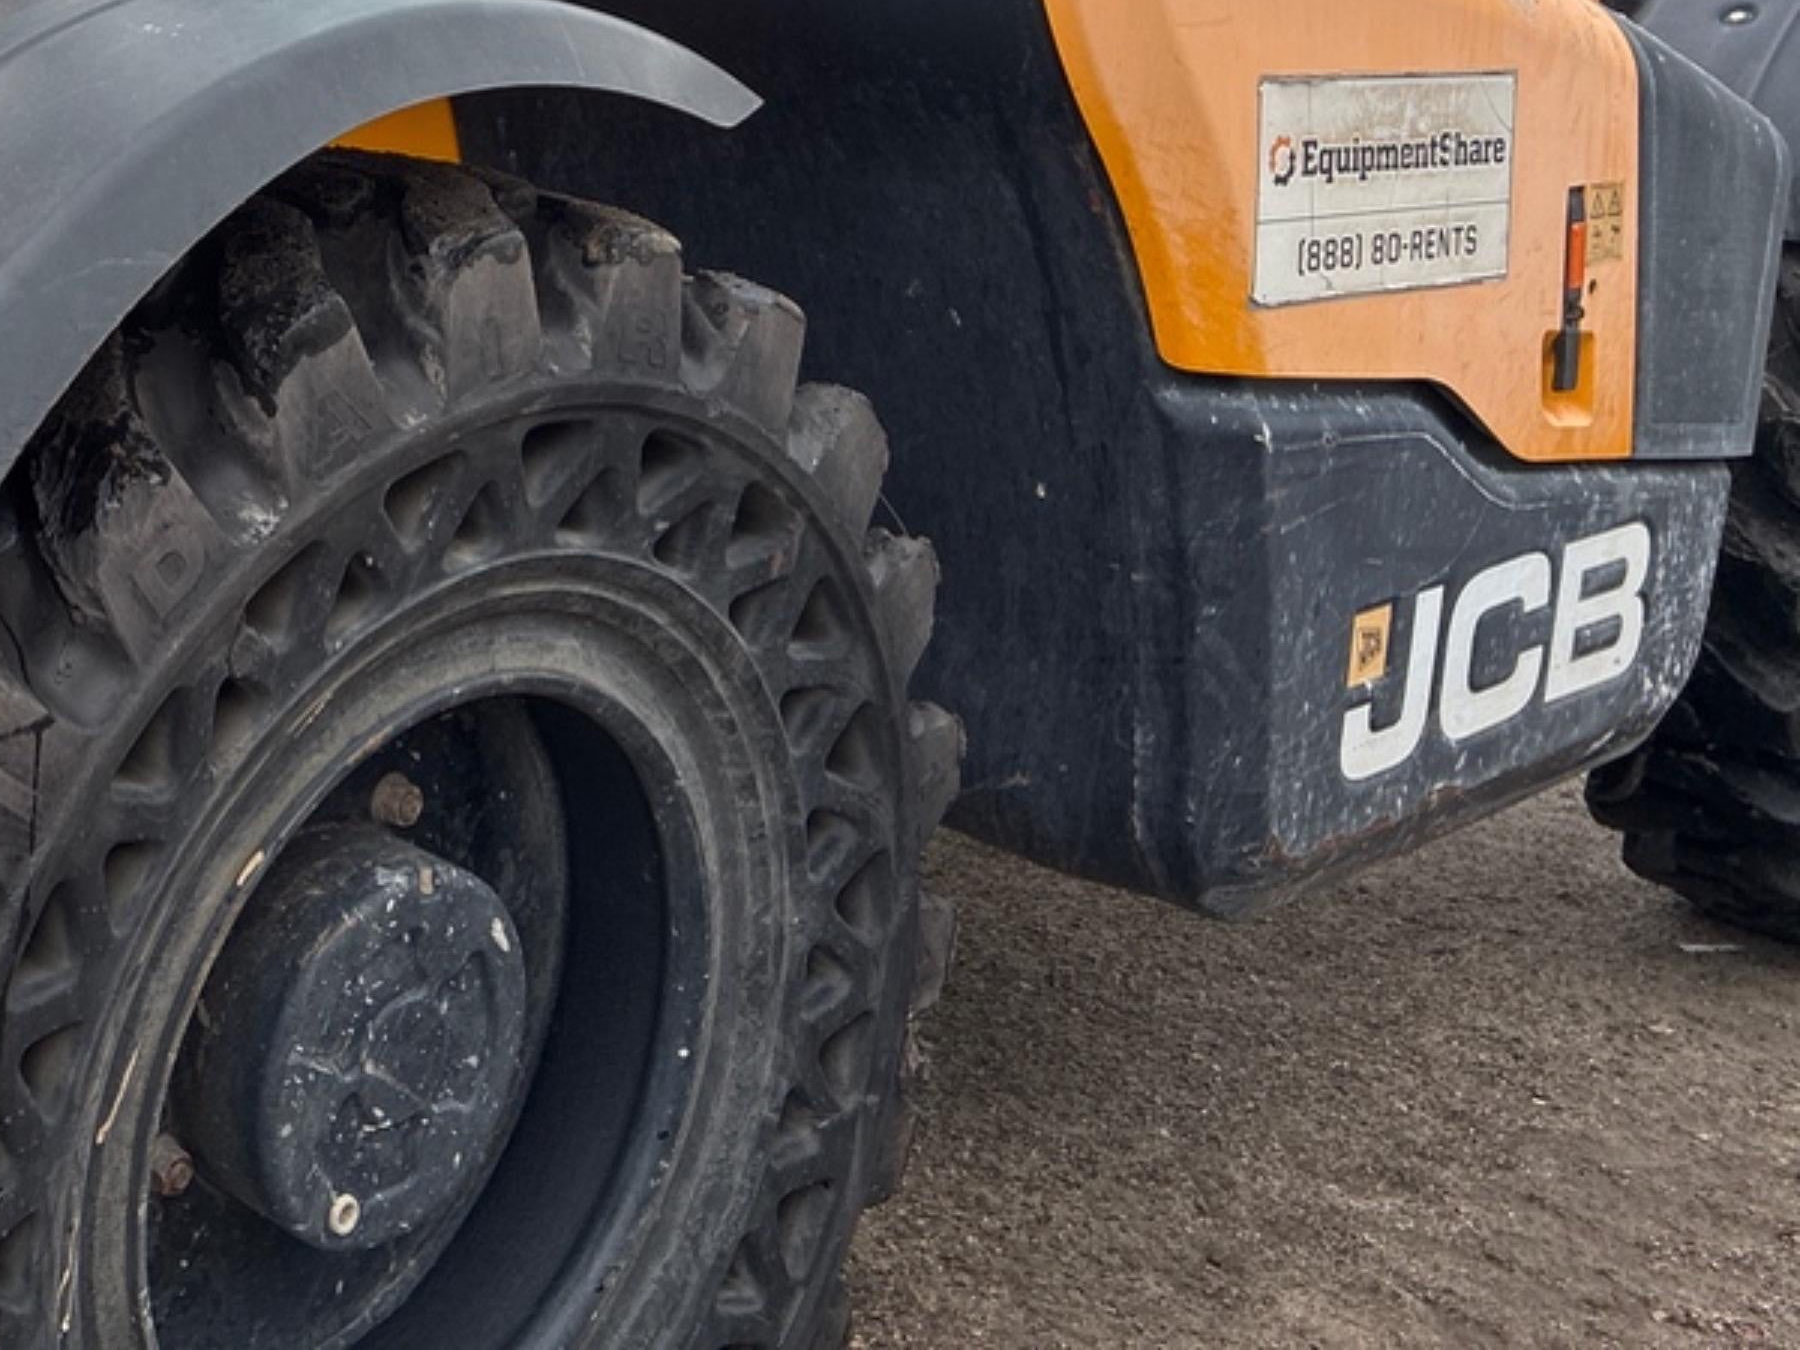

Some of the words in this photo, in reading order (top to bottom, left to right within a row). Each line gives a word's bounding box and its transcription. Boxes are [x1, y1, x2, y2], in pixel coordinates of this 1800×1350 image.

[1302, 132, 1506, 183] EquipmentShare
[1298, 233, 1363, 277] (888)
[1370, 224, 1478, 264] 80-RENTS
[1339, 520, 1652, 782] JCB
